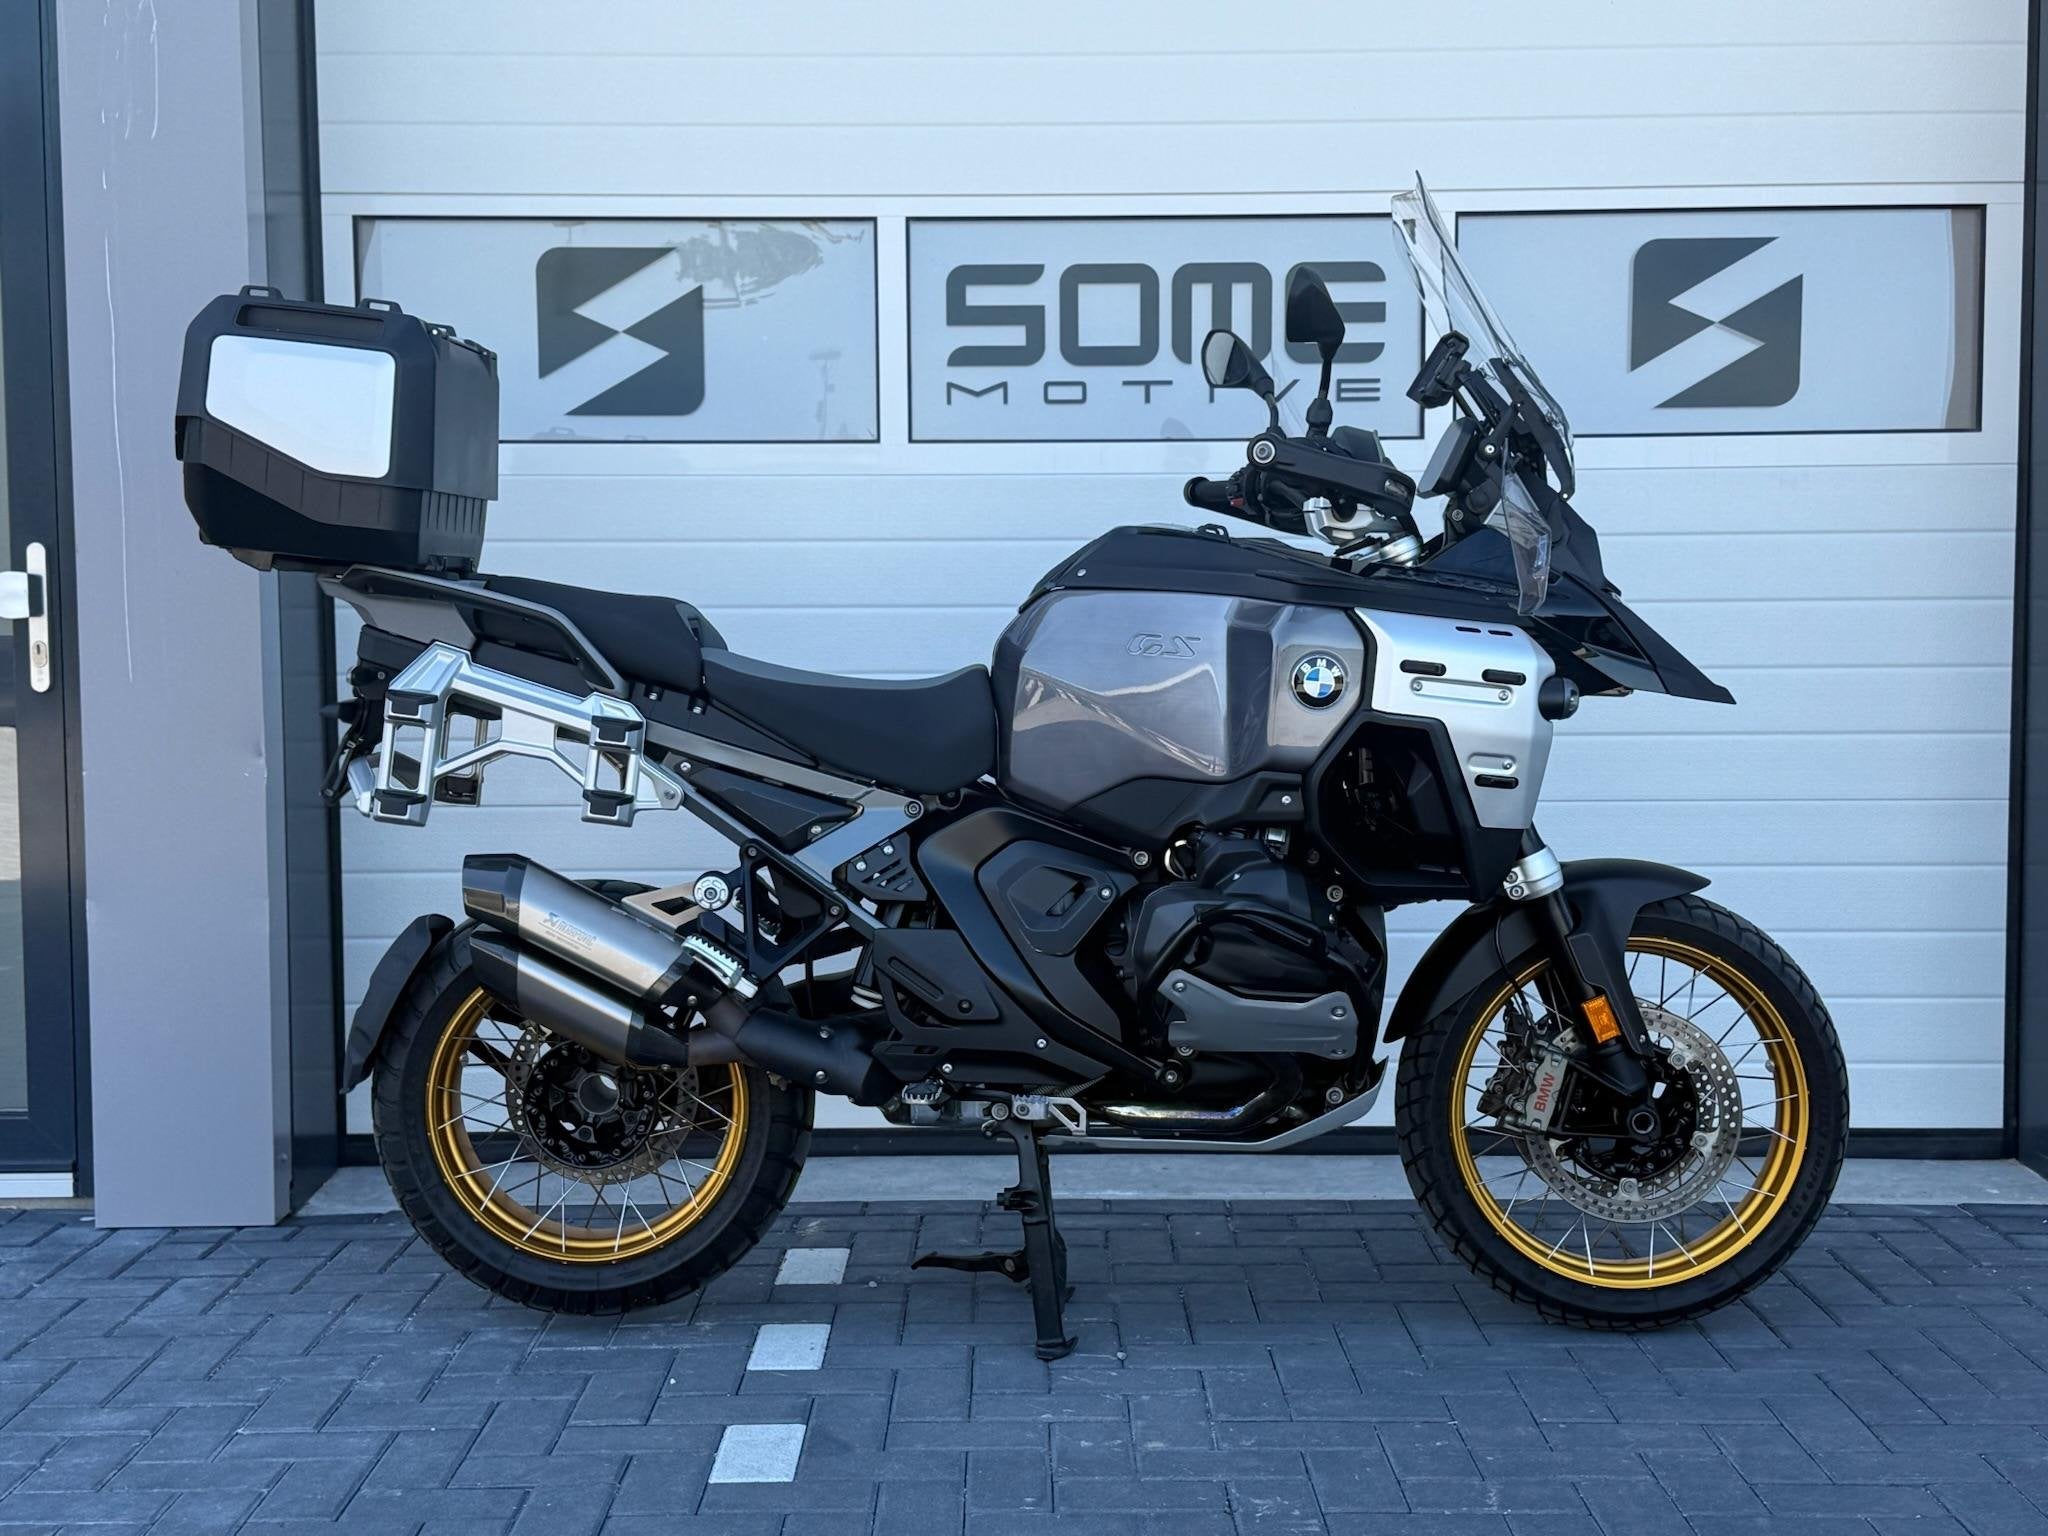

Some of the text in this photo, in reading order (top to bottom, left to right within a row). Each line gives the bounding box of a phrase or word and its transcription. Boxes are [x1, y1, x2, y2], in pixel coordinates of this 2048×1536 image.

[946, 261, 1386, 367] SOME
[1300, 658, 1342, 677] BMW
[1534, 1072, 1554, 1112] BMW
